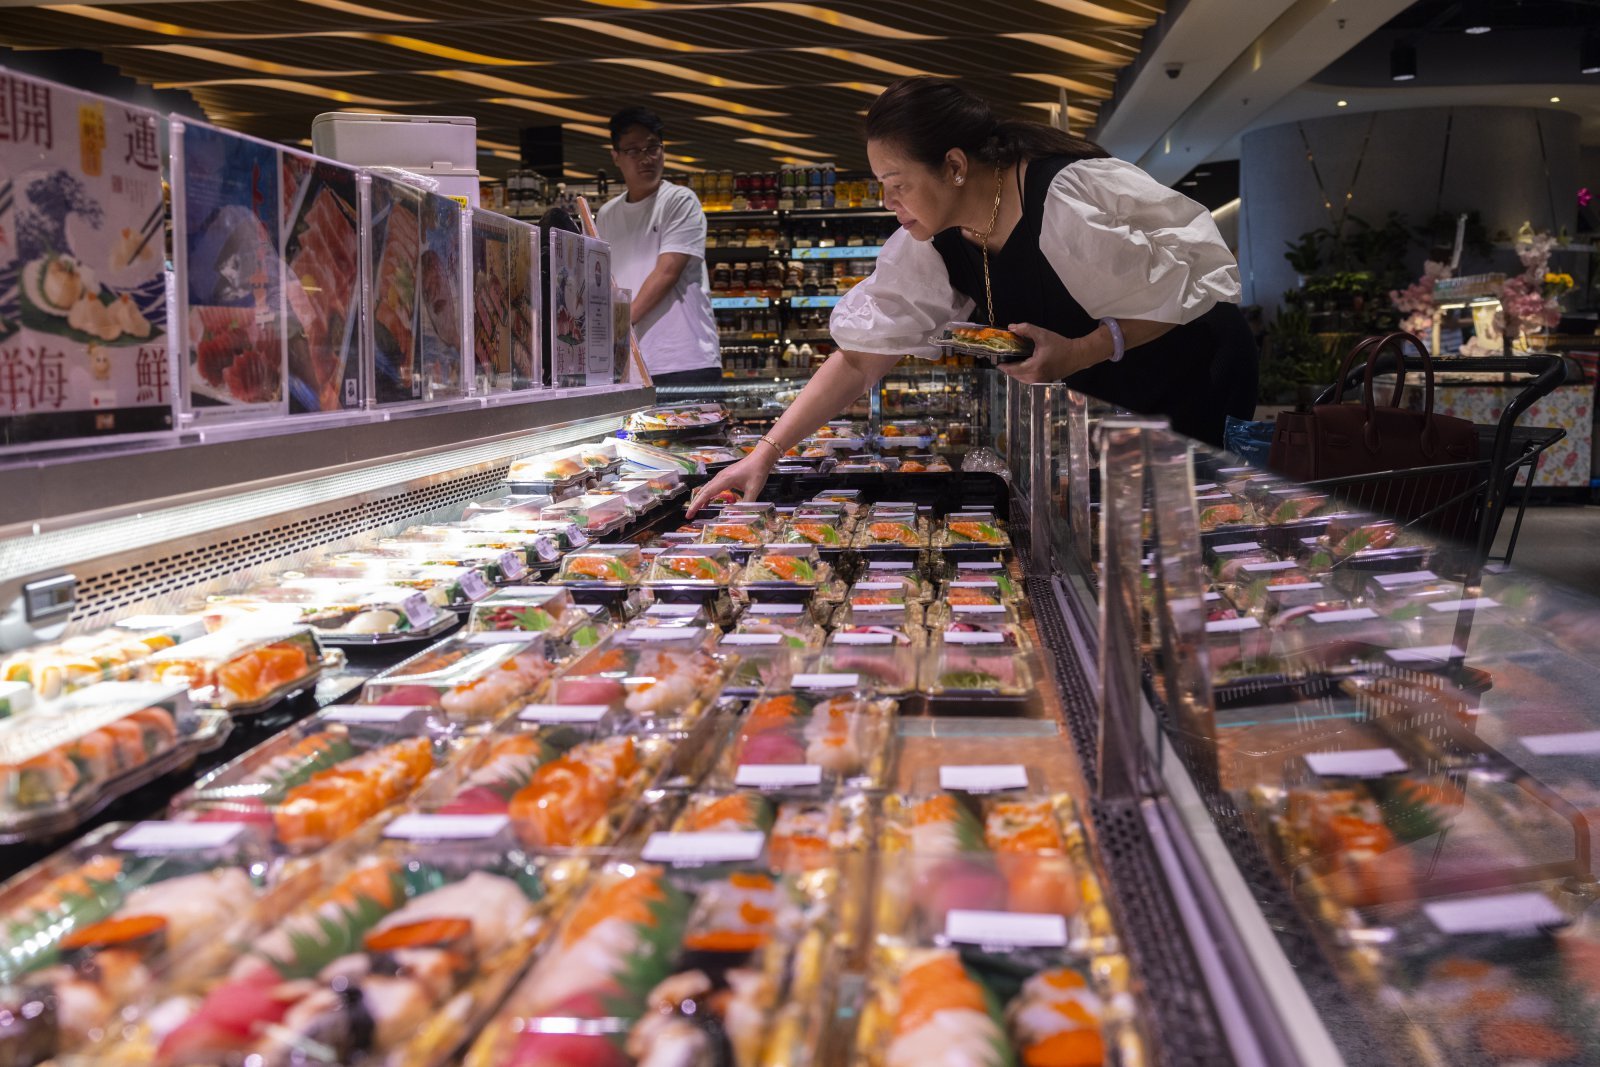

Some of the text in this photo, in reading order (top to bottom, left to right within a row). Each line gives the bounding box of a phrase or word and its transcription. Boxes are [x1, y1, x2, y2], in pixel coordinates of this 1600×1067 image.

[10, 76, 53, 150] 開
[124, 109, 160, 172] 運
[26, 346, 170, 409] 海 鮮
